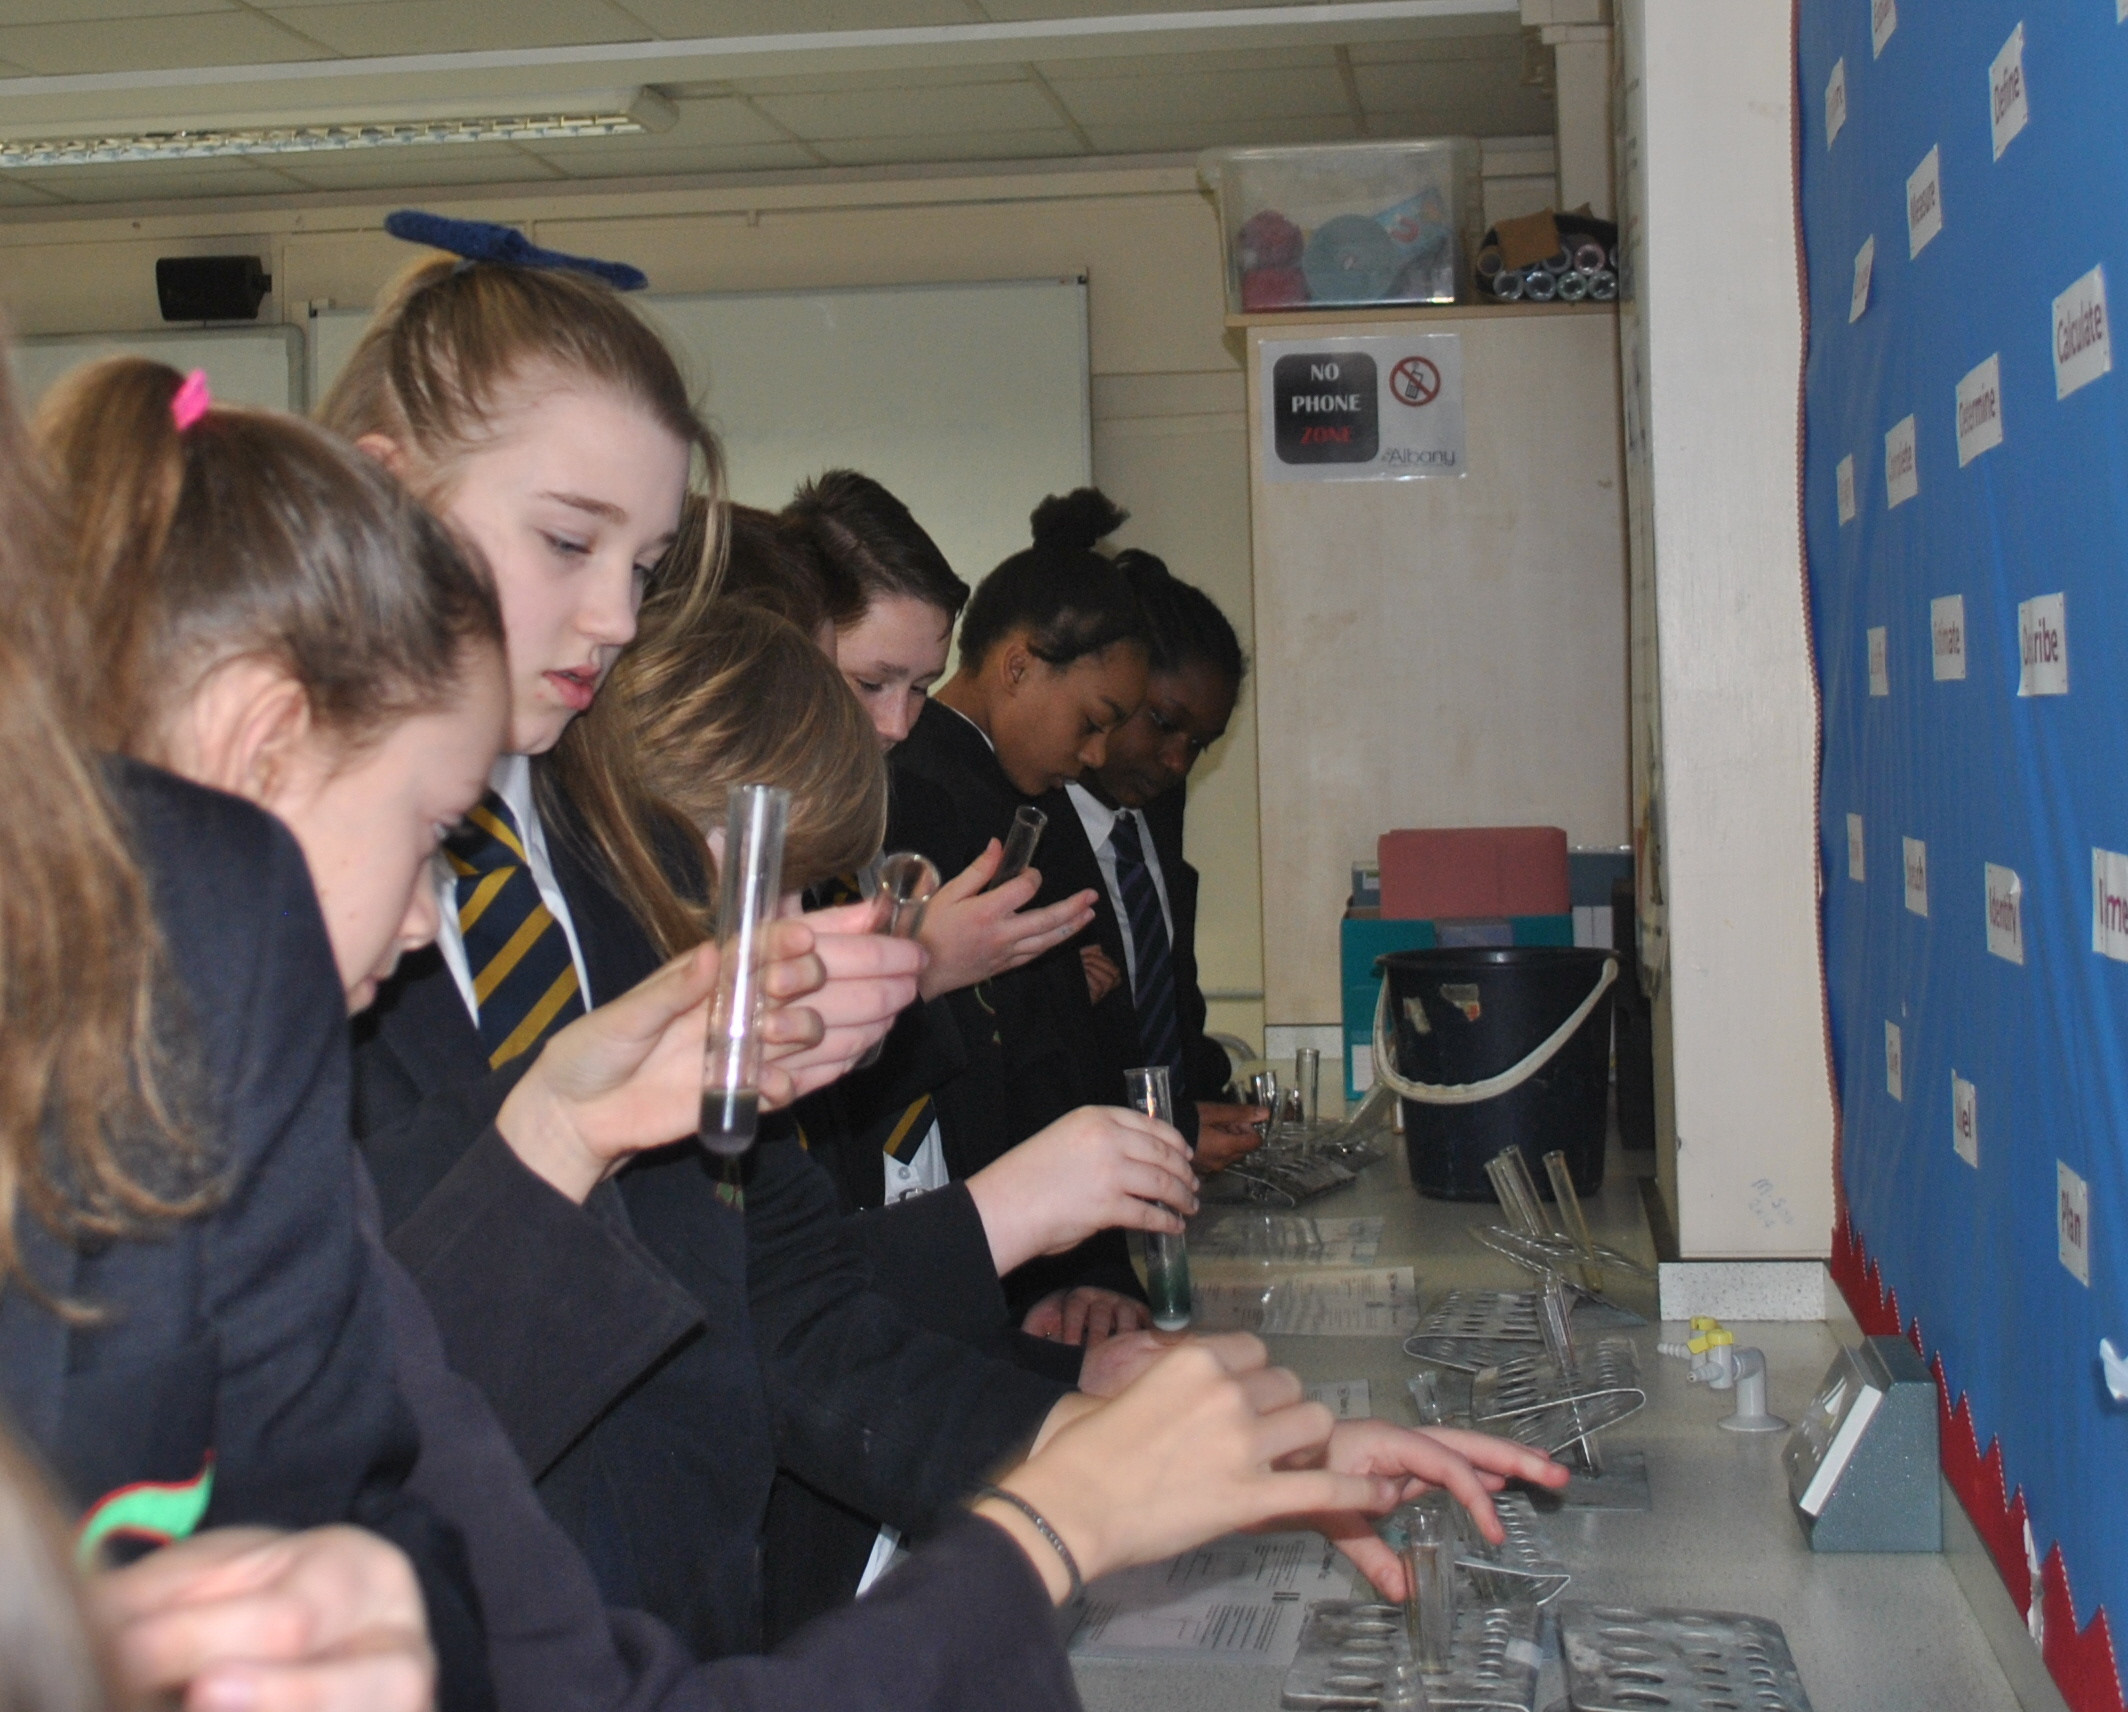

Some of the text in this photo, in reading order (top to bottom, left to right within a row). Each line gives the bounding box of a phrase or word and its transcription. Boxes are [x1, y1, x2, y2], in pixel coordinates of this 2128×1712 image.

[2057, 299, 2103, 364] Calculate
[1310, 363, 1340, 381] NO
[1291, 394, 1362, 414] PHONE
[1301, 426, 1354, 445] ZONE
[2062, 1190, 2082, 1250] Plan
